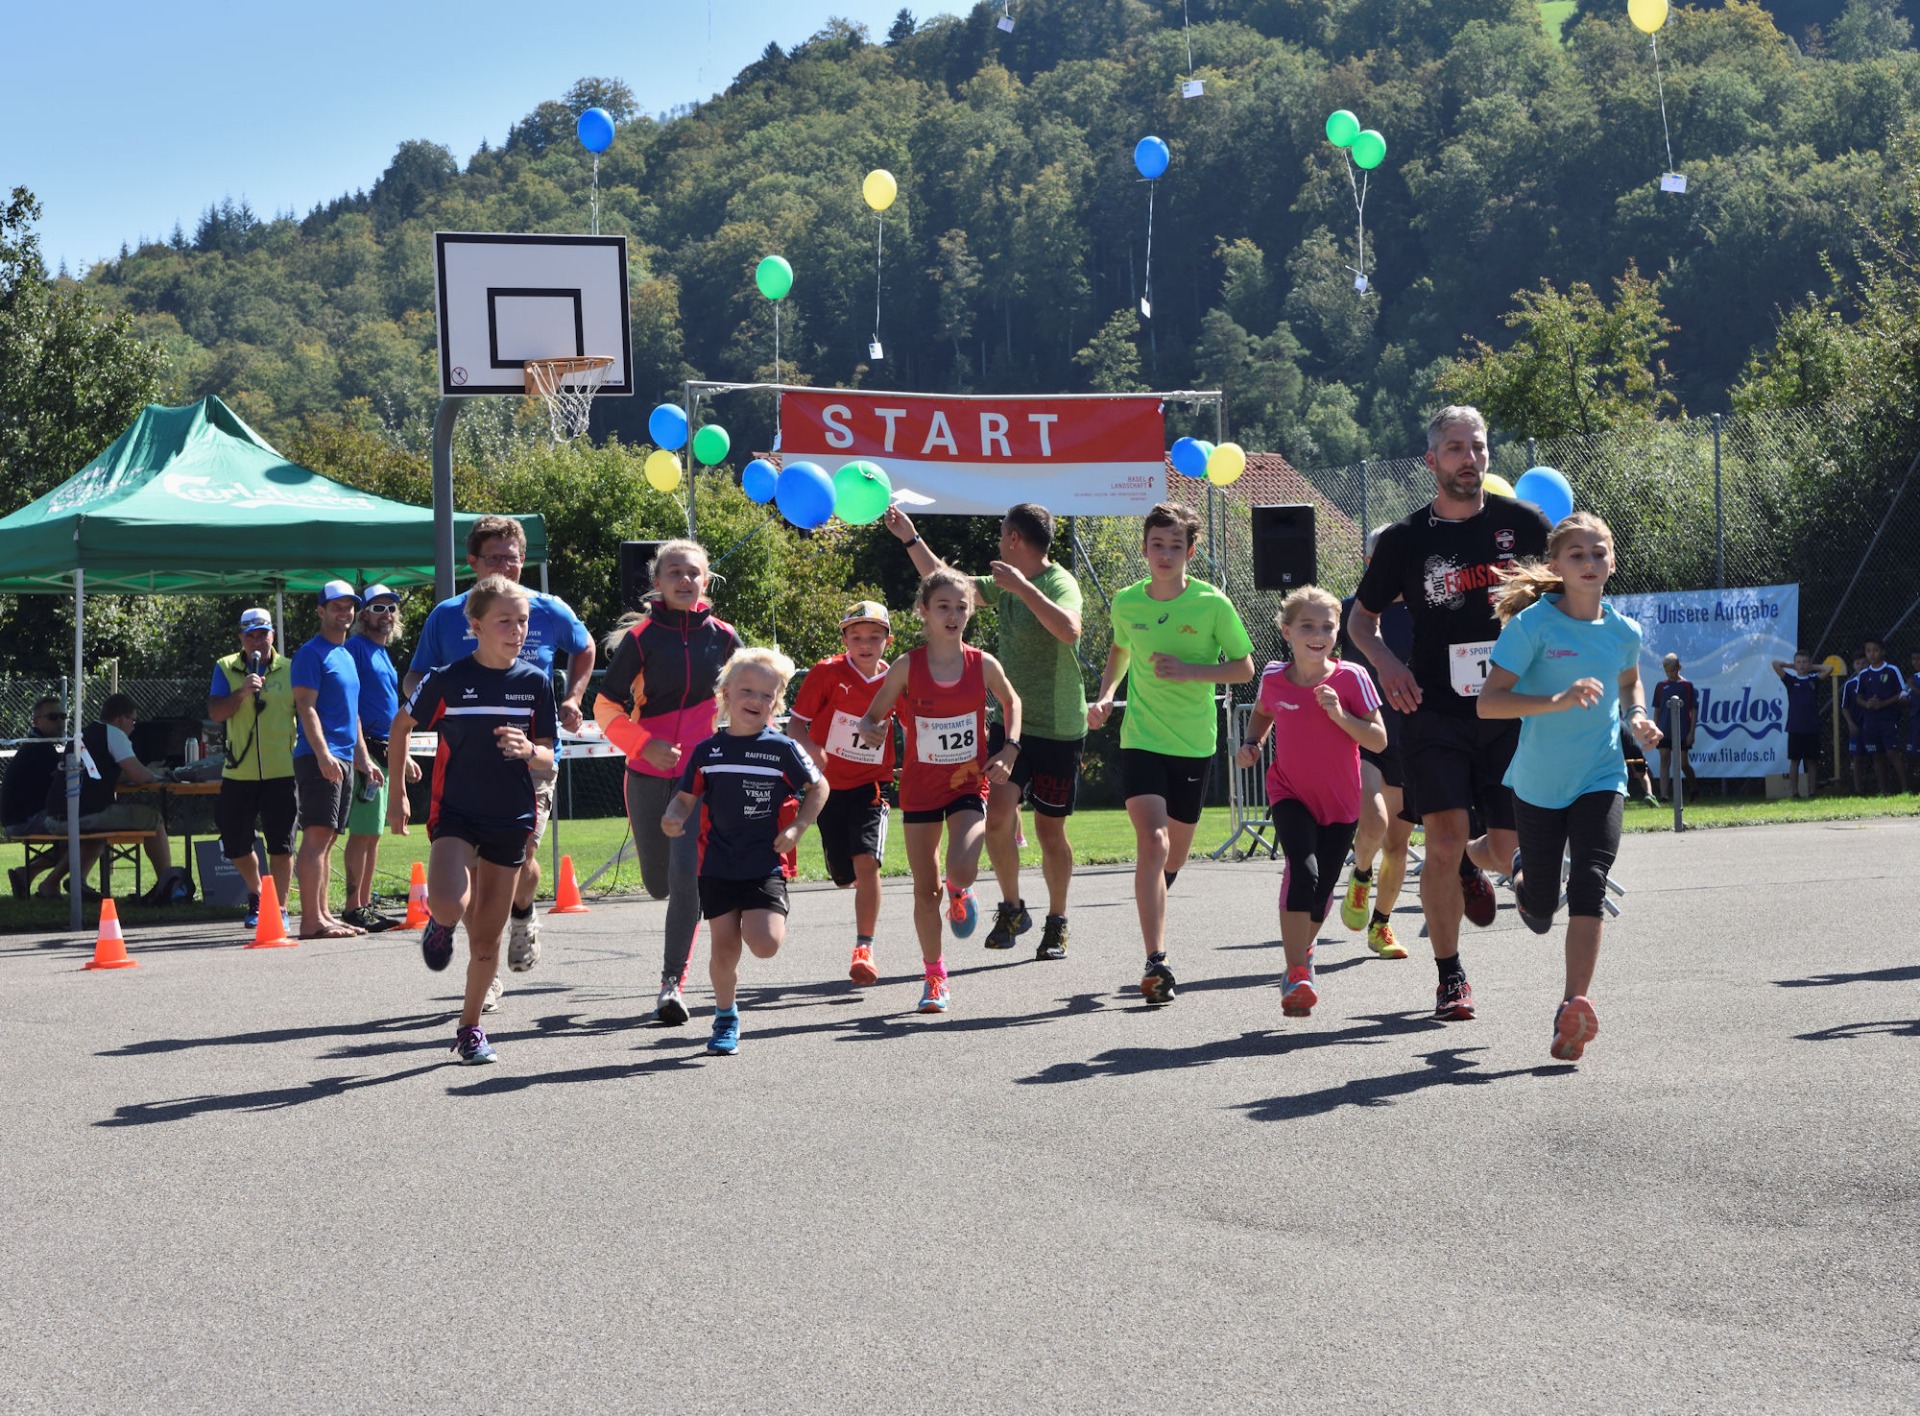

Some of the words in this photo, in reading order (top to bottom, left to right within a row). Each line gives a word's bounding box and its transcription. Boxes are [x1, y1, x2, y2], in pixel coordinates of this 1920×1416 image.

[822, 403, 1058, 457] START
[163, 474, 376, 510] Carlsberg
[1657, 604, 1709, 625] Unsere
[1714, 598, 1779, 625] Aufgabe
[930, 719, 965, 731] SPORTAMT
[938, 729, 975, 751] 128
[744, 751, 781, 762] RAIFFEISEN
[1688, 747, 1776, 764] www.filados.ch
[745, 789, 771, 798] VISAM
